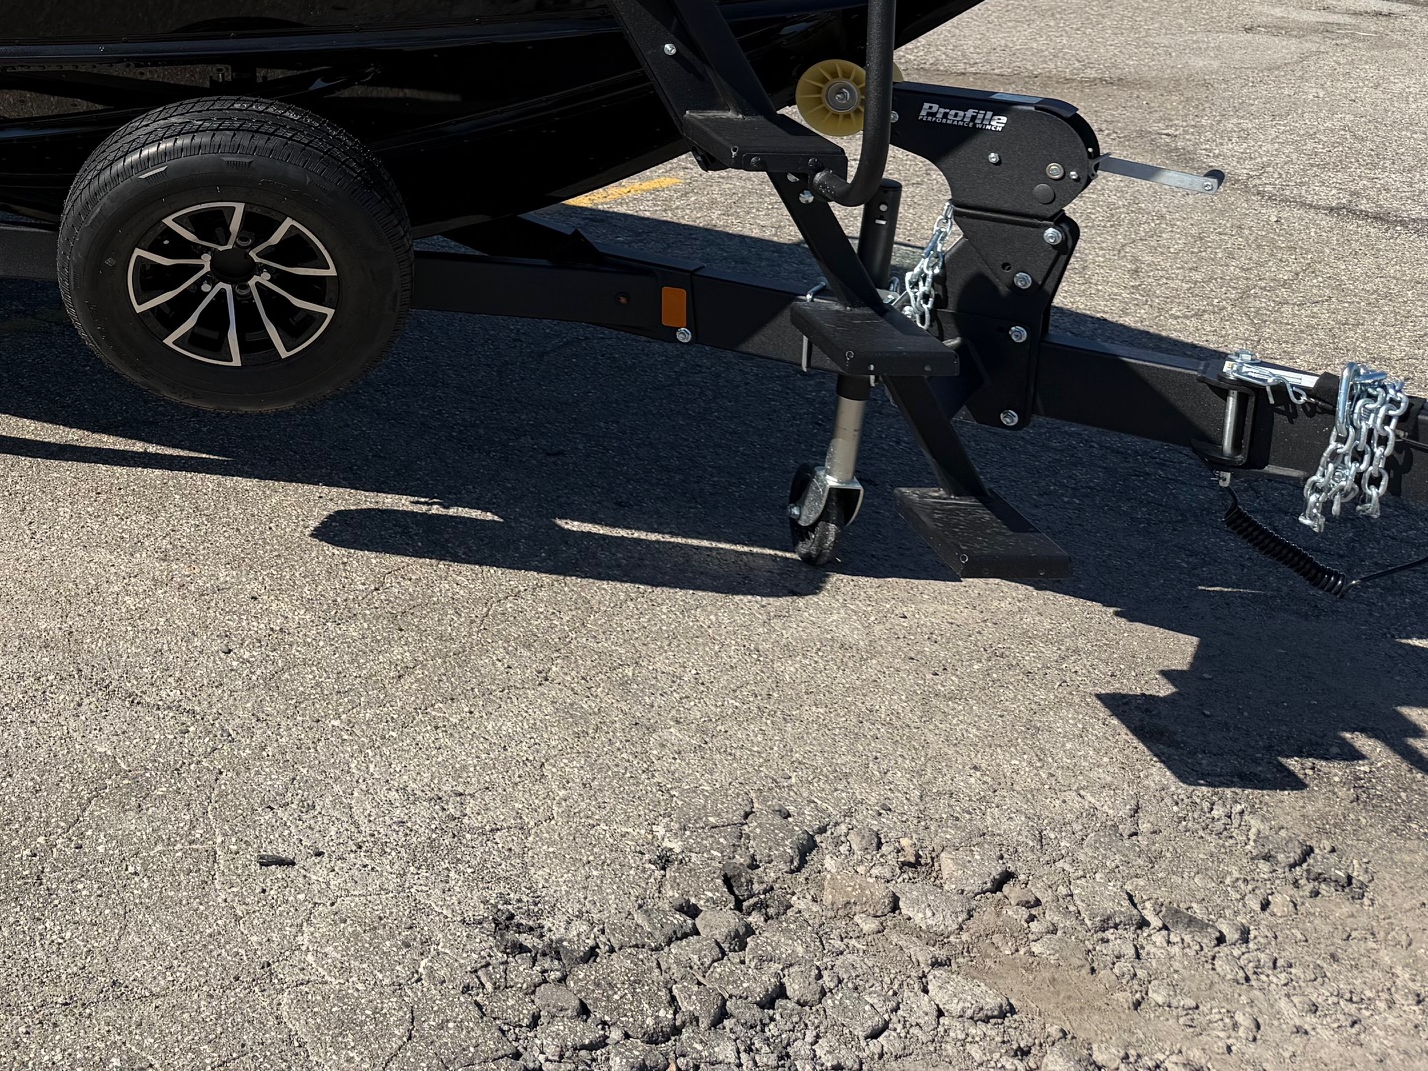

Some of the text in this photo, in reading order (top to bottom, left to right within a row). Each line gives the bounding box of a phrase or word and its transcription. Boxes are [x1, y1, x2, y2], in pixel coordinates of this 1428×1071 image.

[918, 116, 1003, 132] PERFORMANCE WINCH
[919, 102, 1008, 127] Profile
